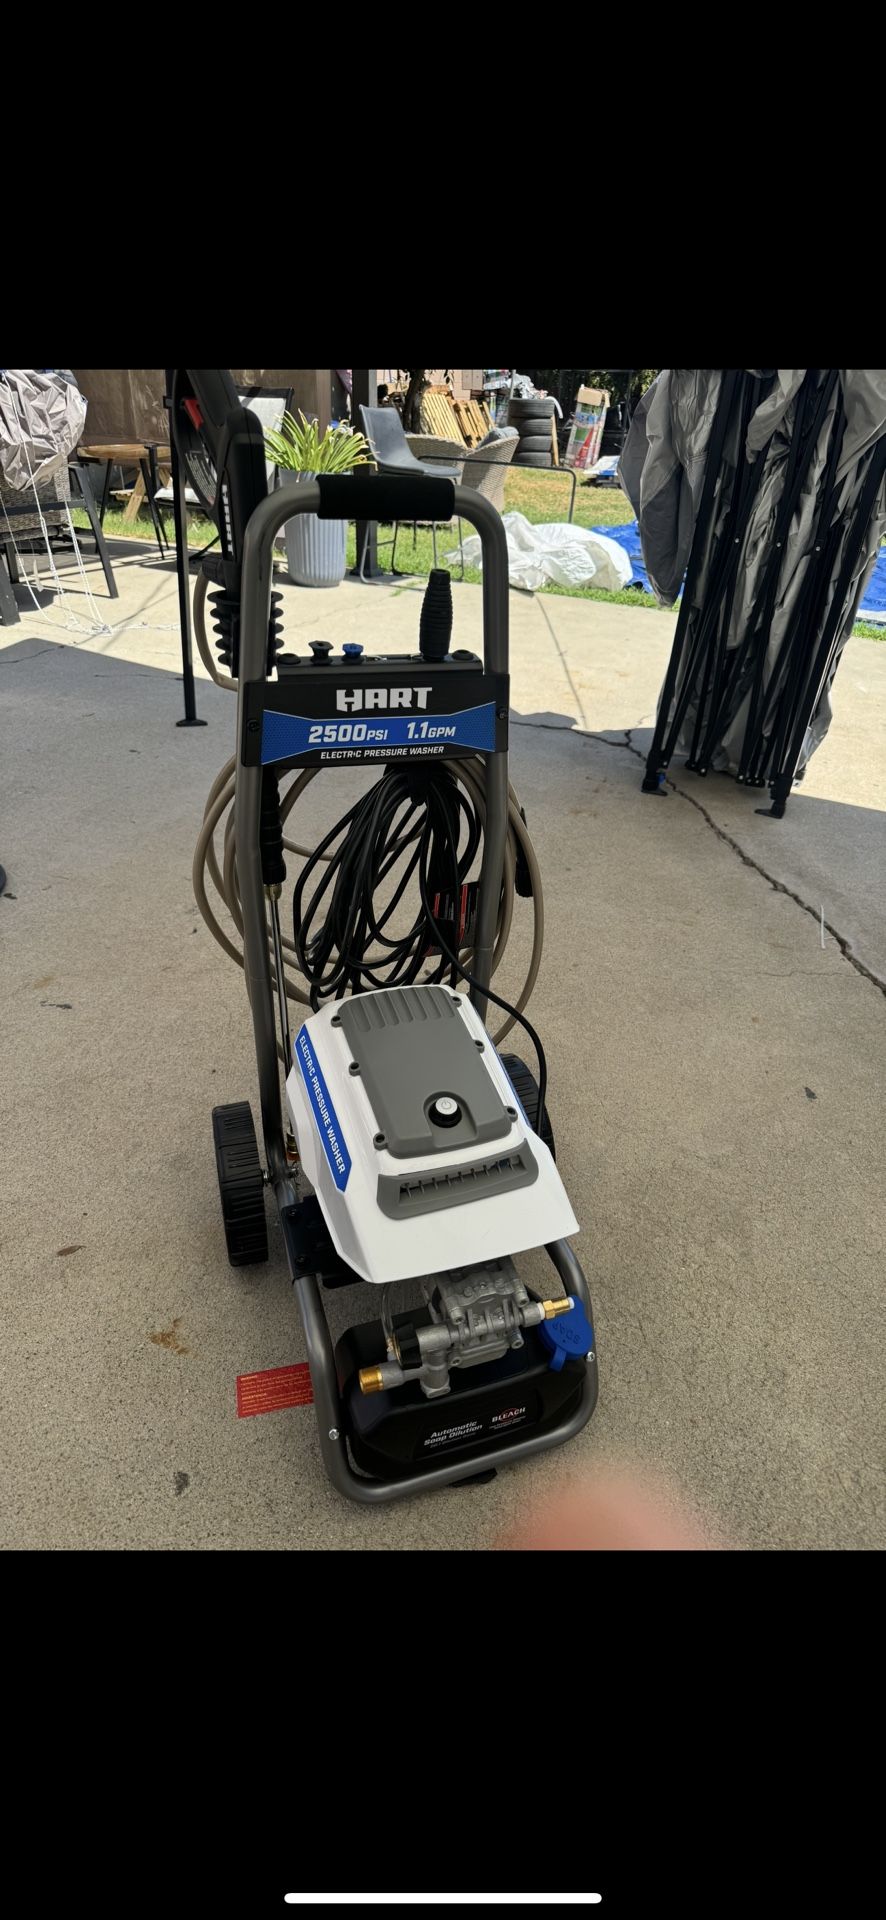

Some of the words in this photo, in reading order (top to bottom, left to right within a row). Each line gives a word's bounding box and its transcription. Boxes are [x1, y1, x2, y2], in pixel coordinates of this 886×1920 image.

[336, 687, 432, 712] HART
[363, 746, 408, 758] PRESSURE
[409, 745, 444, 756] WASHER
[311, 1076, 331, 1127] PRESSURE
[327, 1127, 346, 1174] WASHER
[491, 1406, 526, 1423] BLEACH
[424, 1434, 447, 1446] Soap
[448, 1424, 483, 1439] Dilution
[430, 1421, 478, 1439] Automatic
